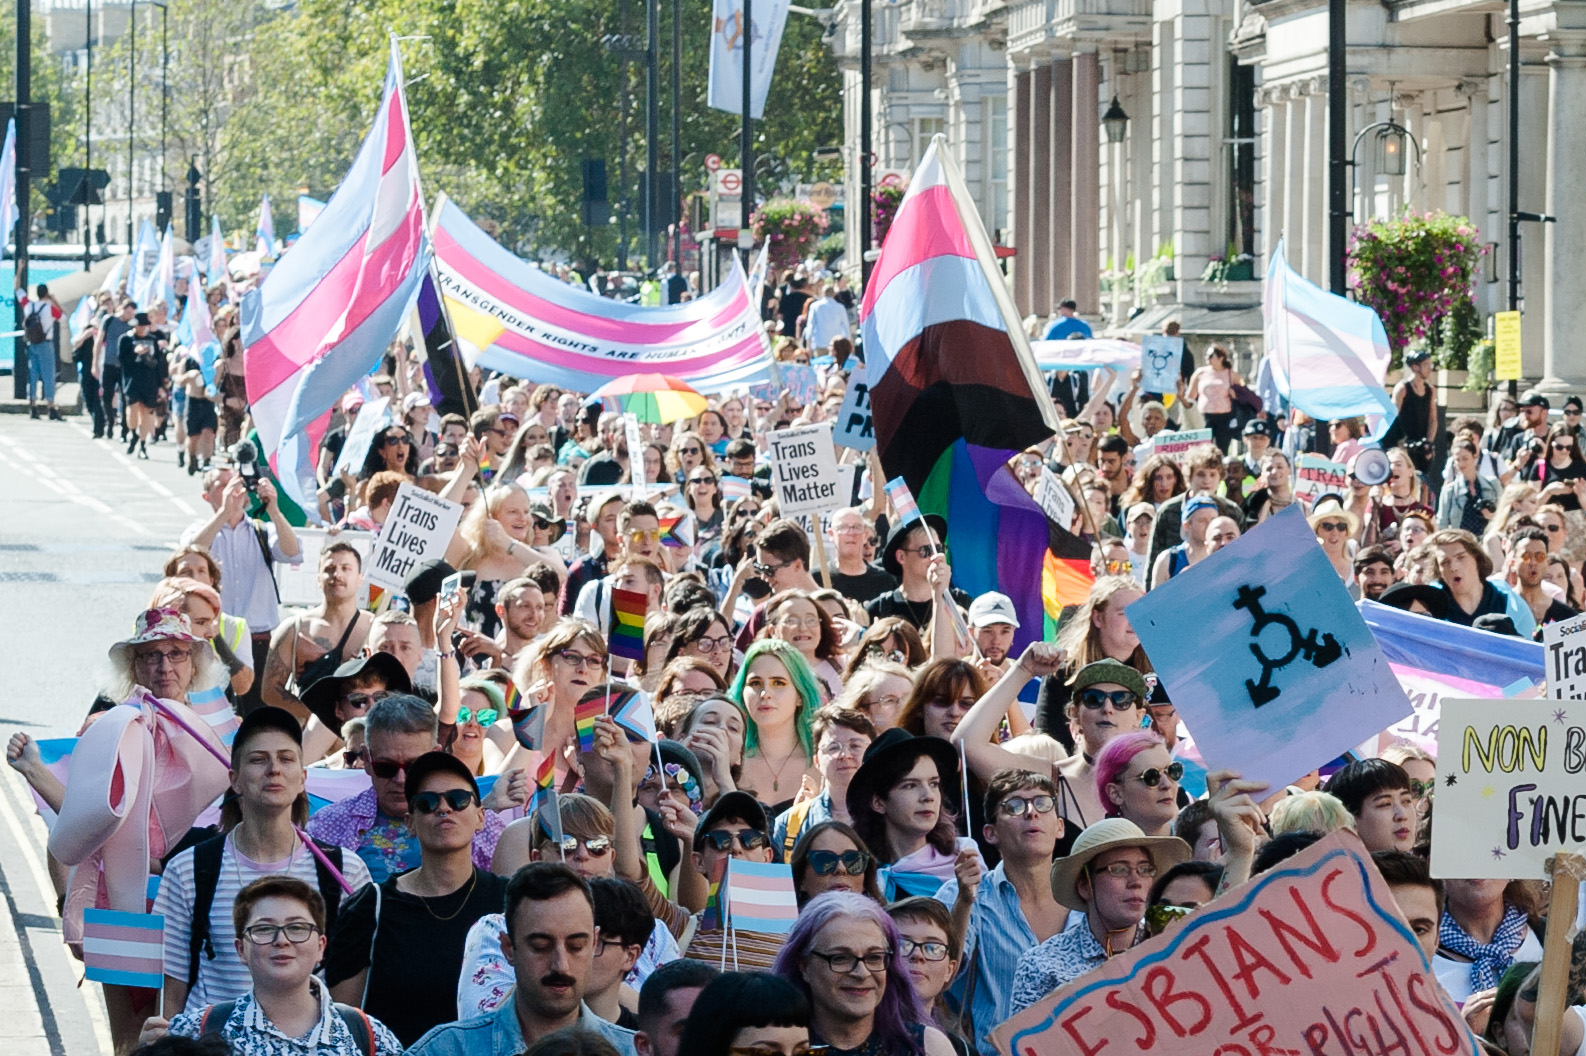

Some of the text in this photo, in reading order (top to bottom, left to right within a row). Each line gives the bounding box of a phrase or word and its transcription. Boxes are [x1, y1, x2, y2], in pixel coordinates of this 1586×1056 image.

[437, 271, 535, 333] TRANSGENDER
[541, 332, 599, 353] RIGHTS
[605, 350, 640, 359] ARE
[771, 441, 816, 460] Trans
[1163, 432, 1199, 444] TRANS
[778, 463, 819, 482] Lives
[782, 481, 836, 504] Matter
[396, 495, 439, 531] Trans
[386, 521, 427, 556] Lives
[1462, 725, 1547, 774] NON
